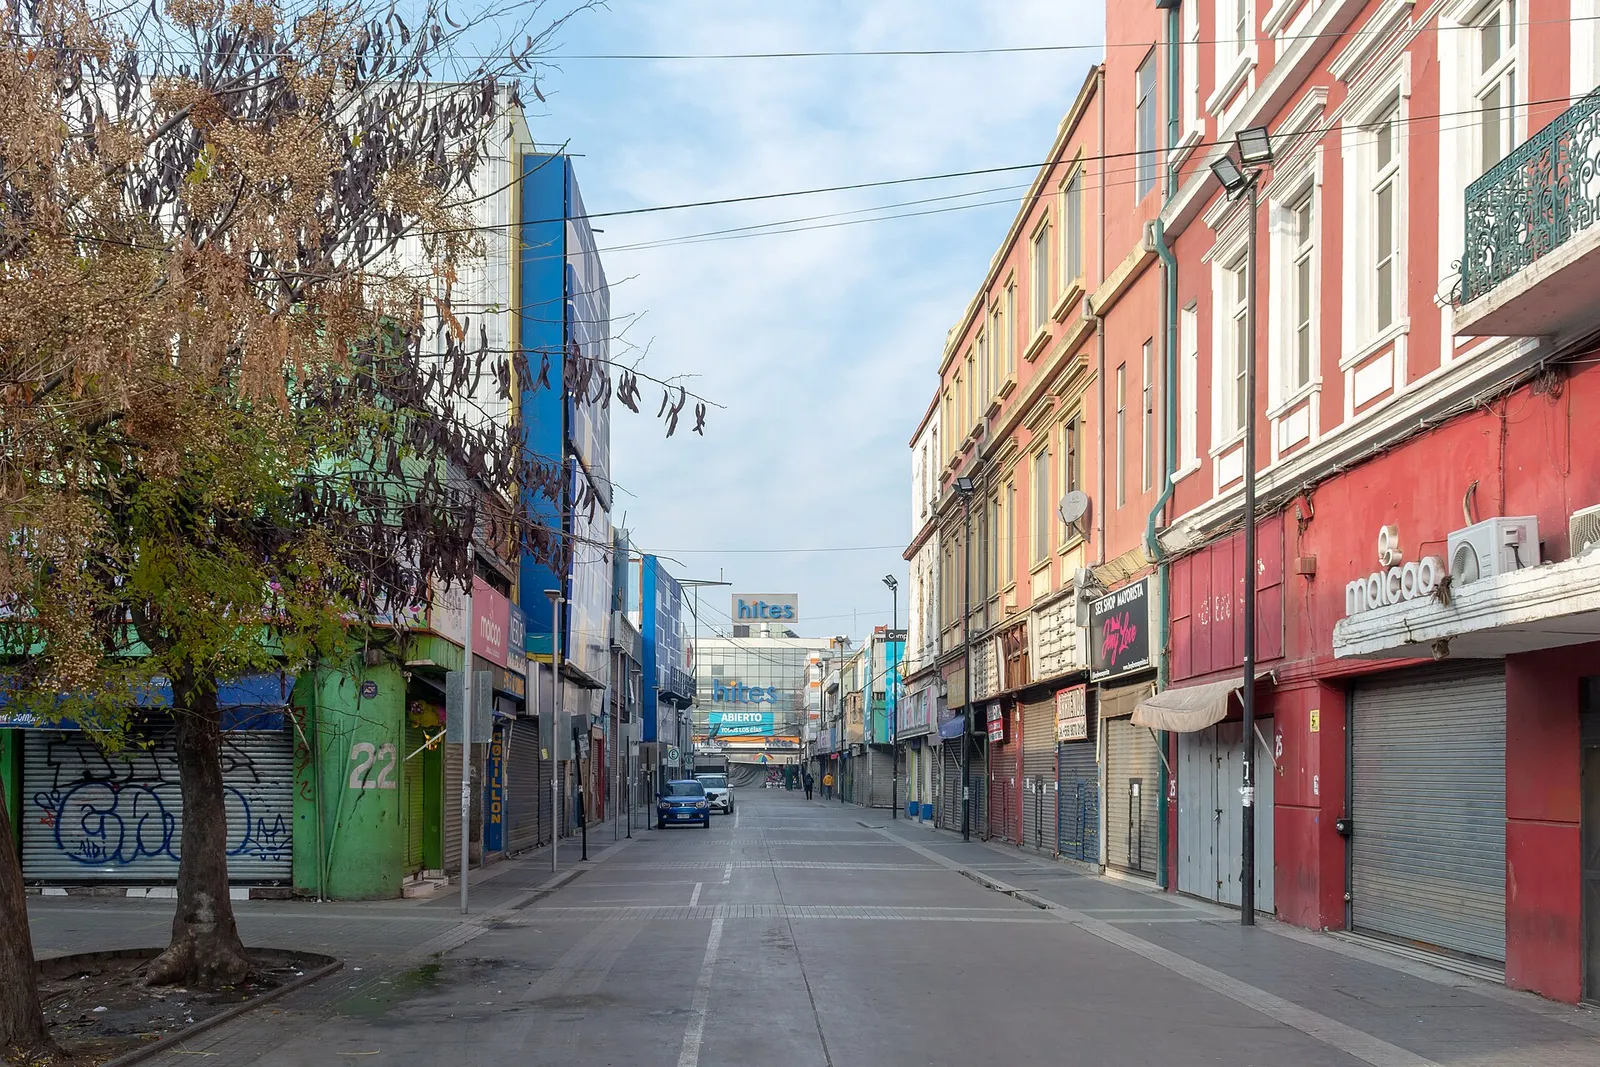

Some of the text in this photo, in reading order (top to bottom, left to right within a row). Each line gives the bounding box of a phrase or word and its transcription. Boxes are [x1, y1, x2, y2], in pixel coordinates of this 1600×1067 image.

[1345, 556, 1436, 616] maicao
[738, 599, 793, 619] hites
[1095, 600, 1104, 616] SEX
[1103, 595, 1116, 613] SHOP
[713, 678, 778, 704] hites
[721, 713, 763, 722] ABIERTO
[349, 742, 396, 789] 22
[491, 733, 502, 824] COTILLON
